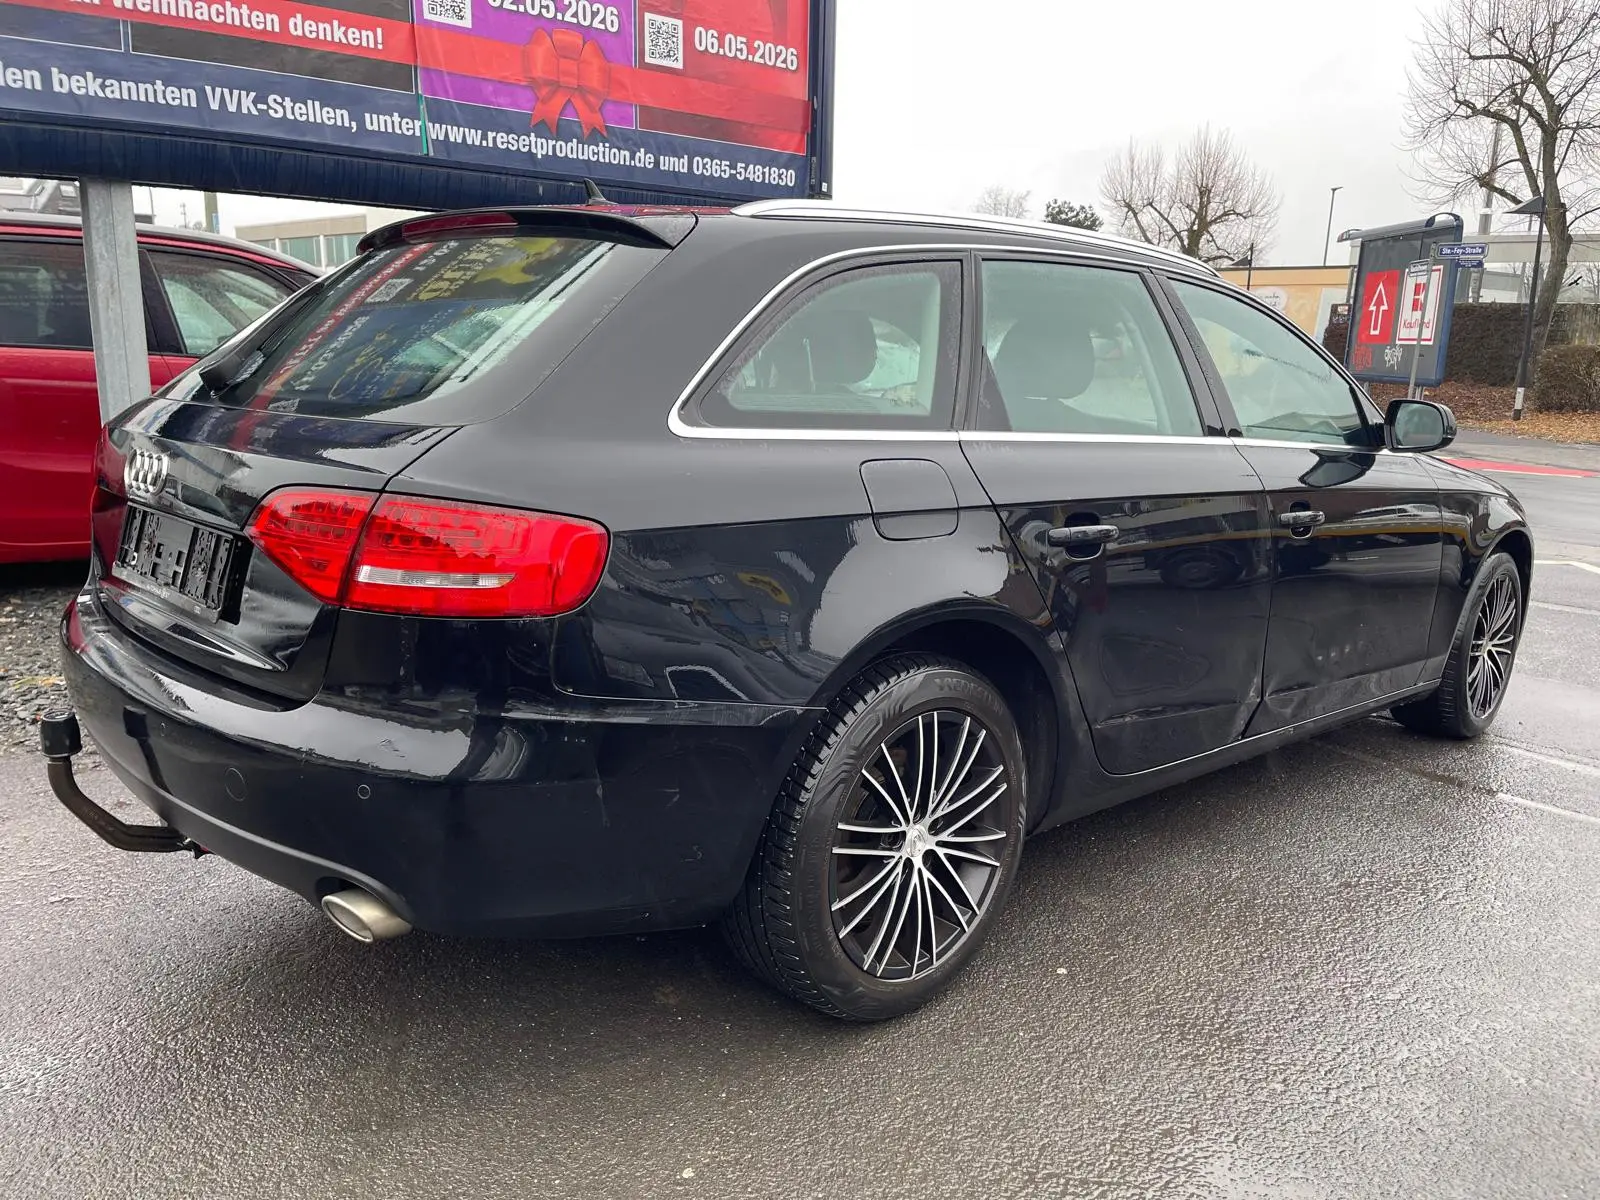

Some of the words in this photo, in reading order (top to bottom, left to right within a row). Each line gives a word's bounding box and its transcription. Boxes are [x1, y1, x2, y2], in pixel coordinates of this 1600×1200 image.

[289, 13, 384, 50] denken!
[487, 0, 620, 33] .05.2026
[694, 27, 799, 71] 06.05.2026
[51, 66, 197, 109] bekannten
[204, 85, 357, 133] VVK-Stellen,
[364, 111, 422, 137] unter
[428, 121, 655, 169] www.resetproduction.de
[659, 155, 689, 174] und
[692, 156, 796, 187] 0365-5481830
